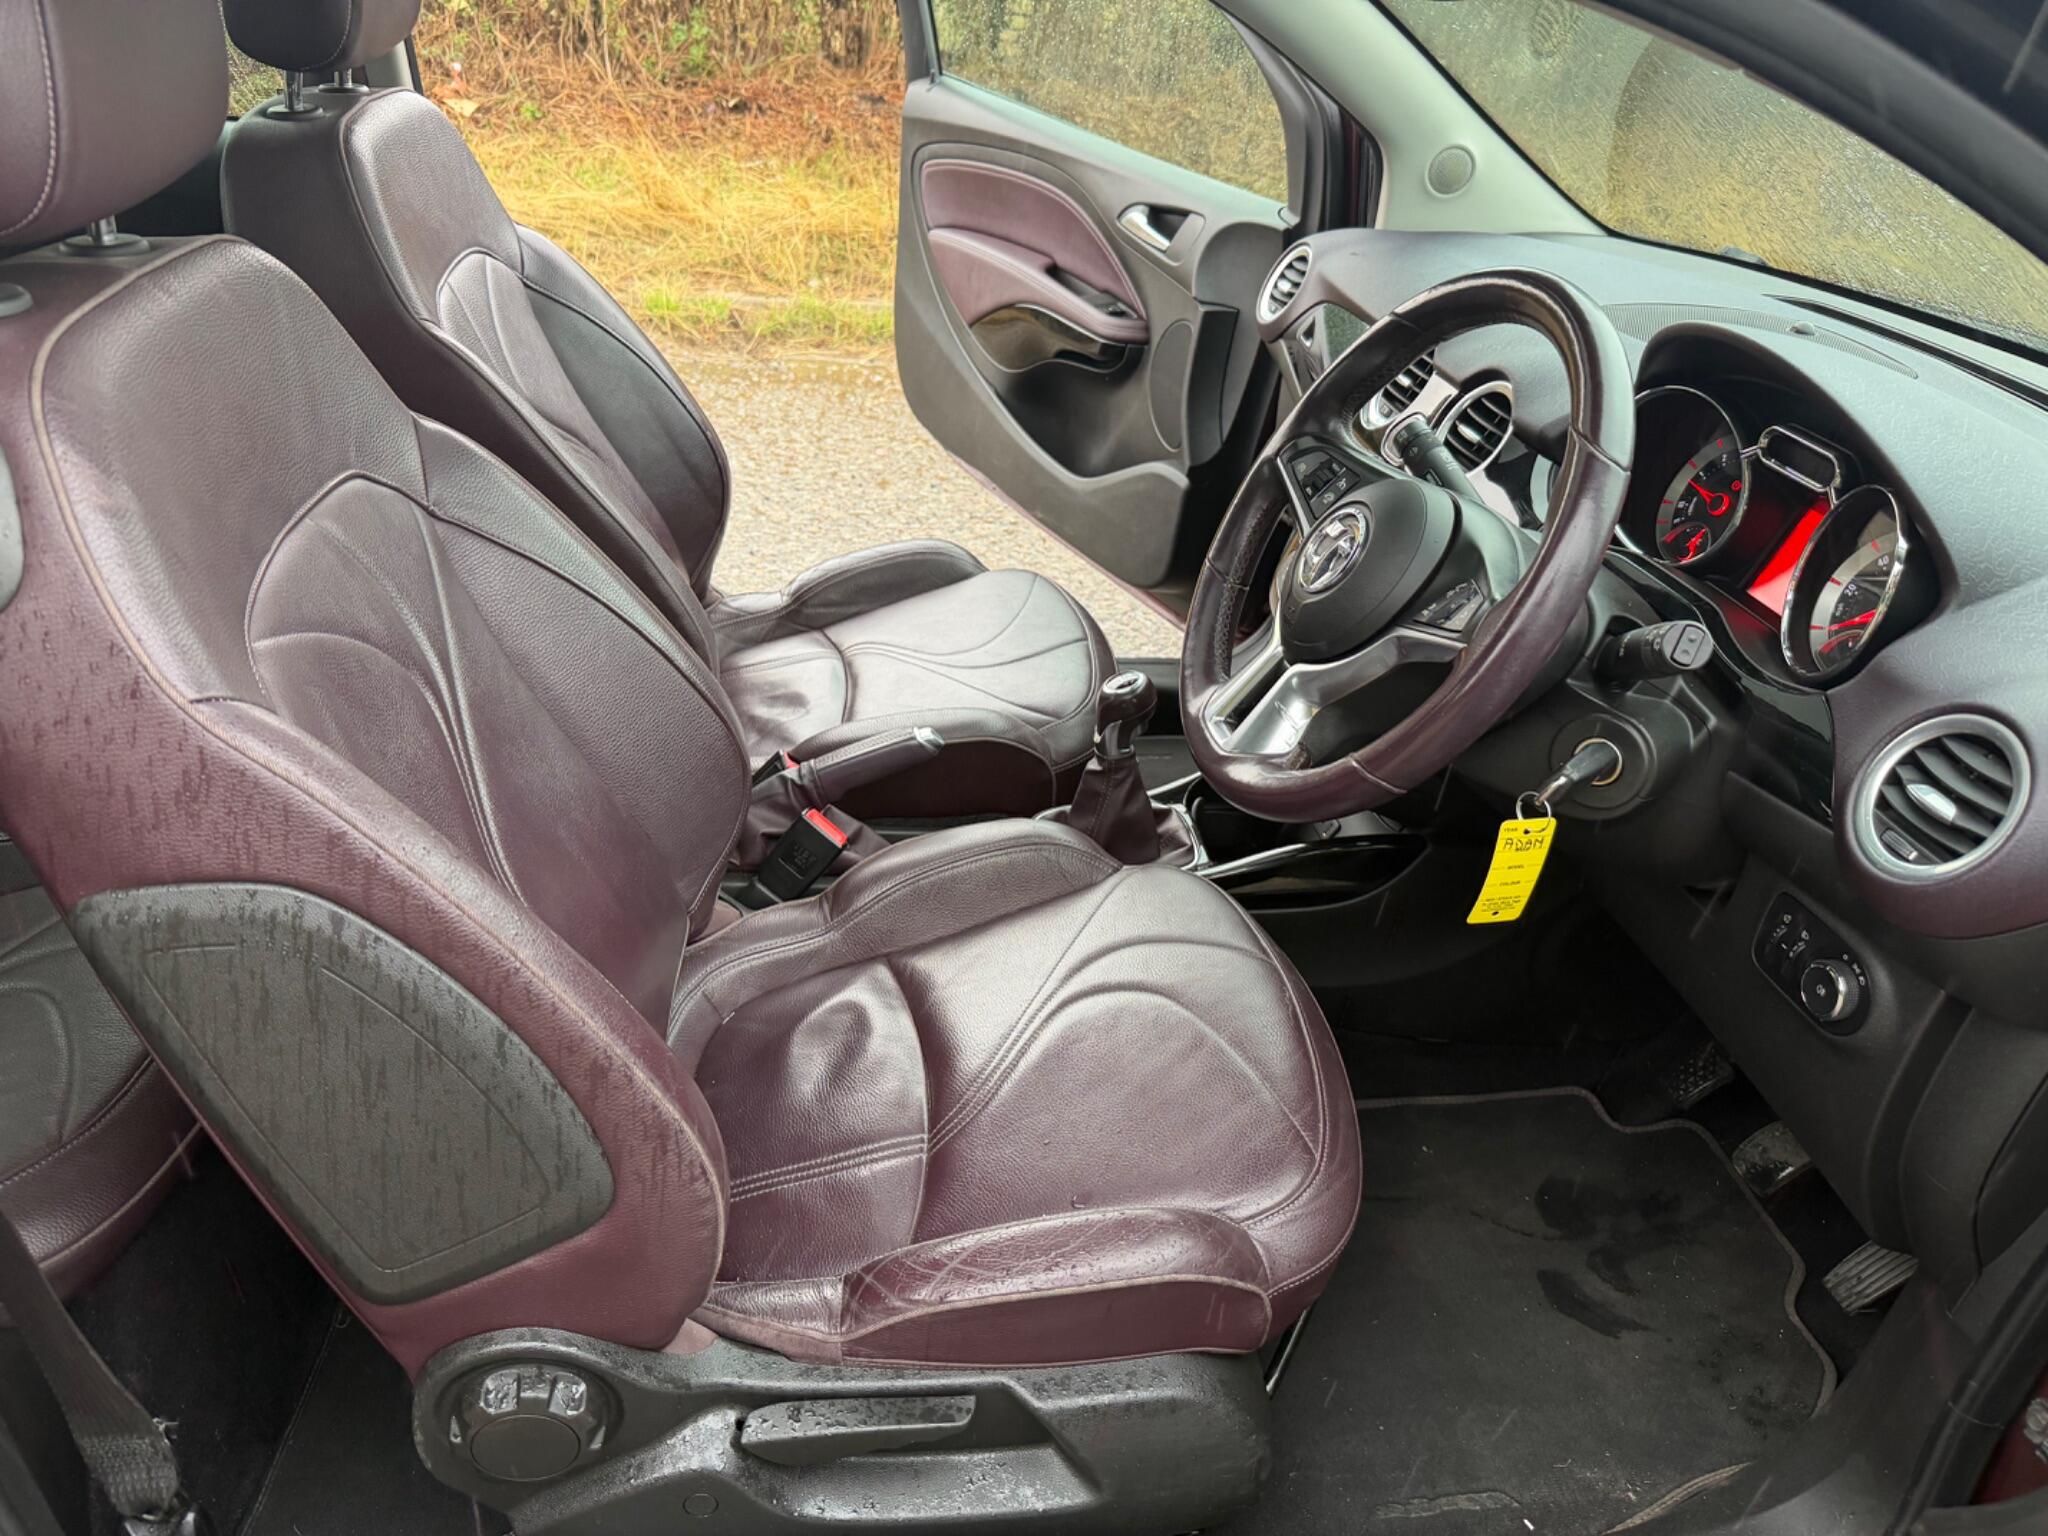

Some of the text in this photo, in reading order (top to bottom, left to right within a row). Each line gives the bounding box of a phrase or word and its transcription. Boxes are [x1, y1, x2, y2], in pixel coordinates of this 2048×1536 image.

[1877, 555, 1890, 566] 40
[1843, 583, 1857, 597] 20
[1503, 837, 1544, 850] ADAM
